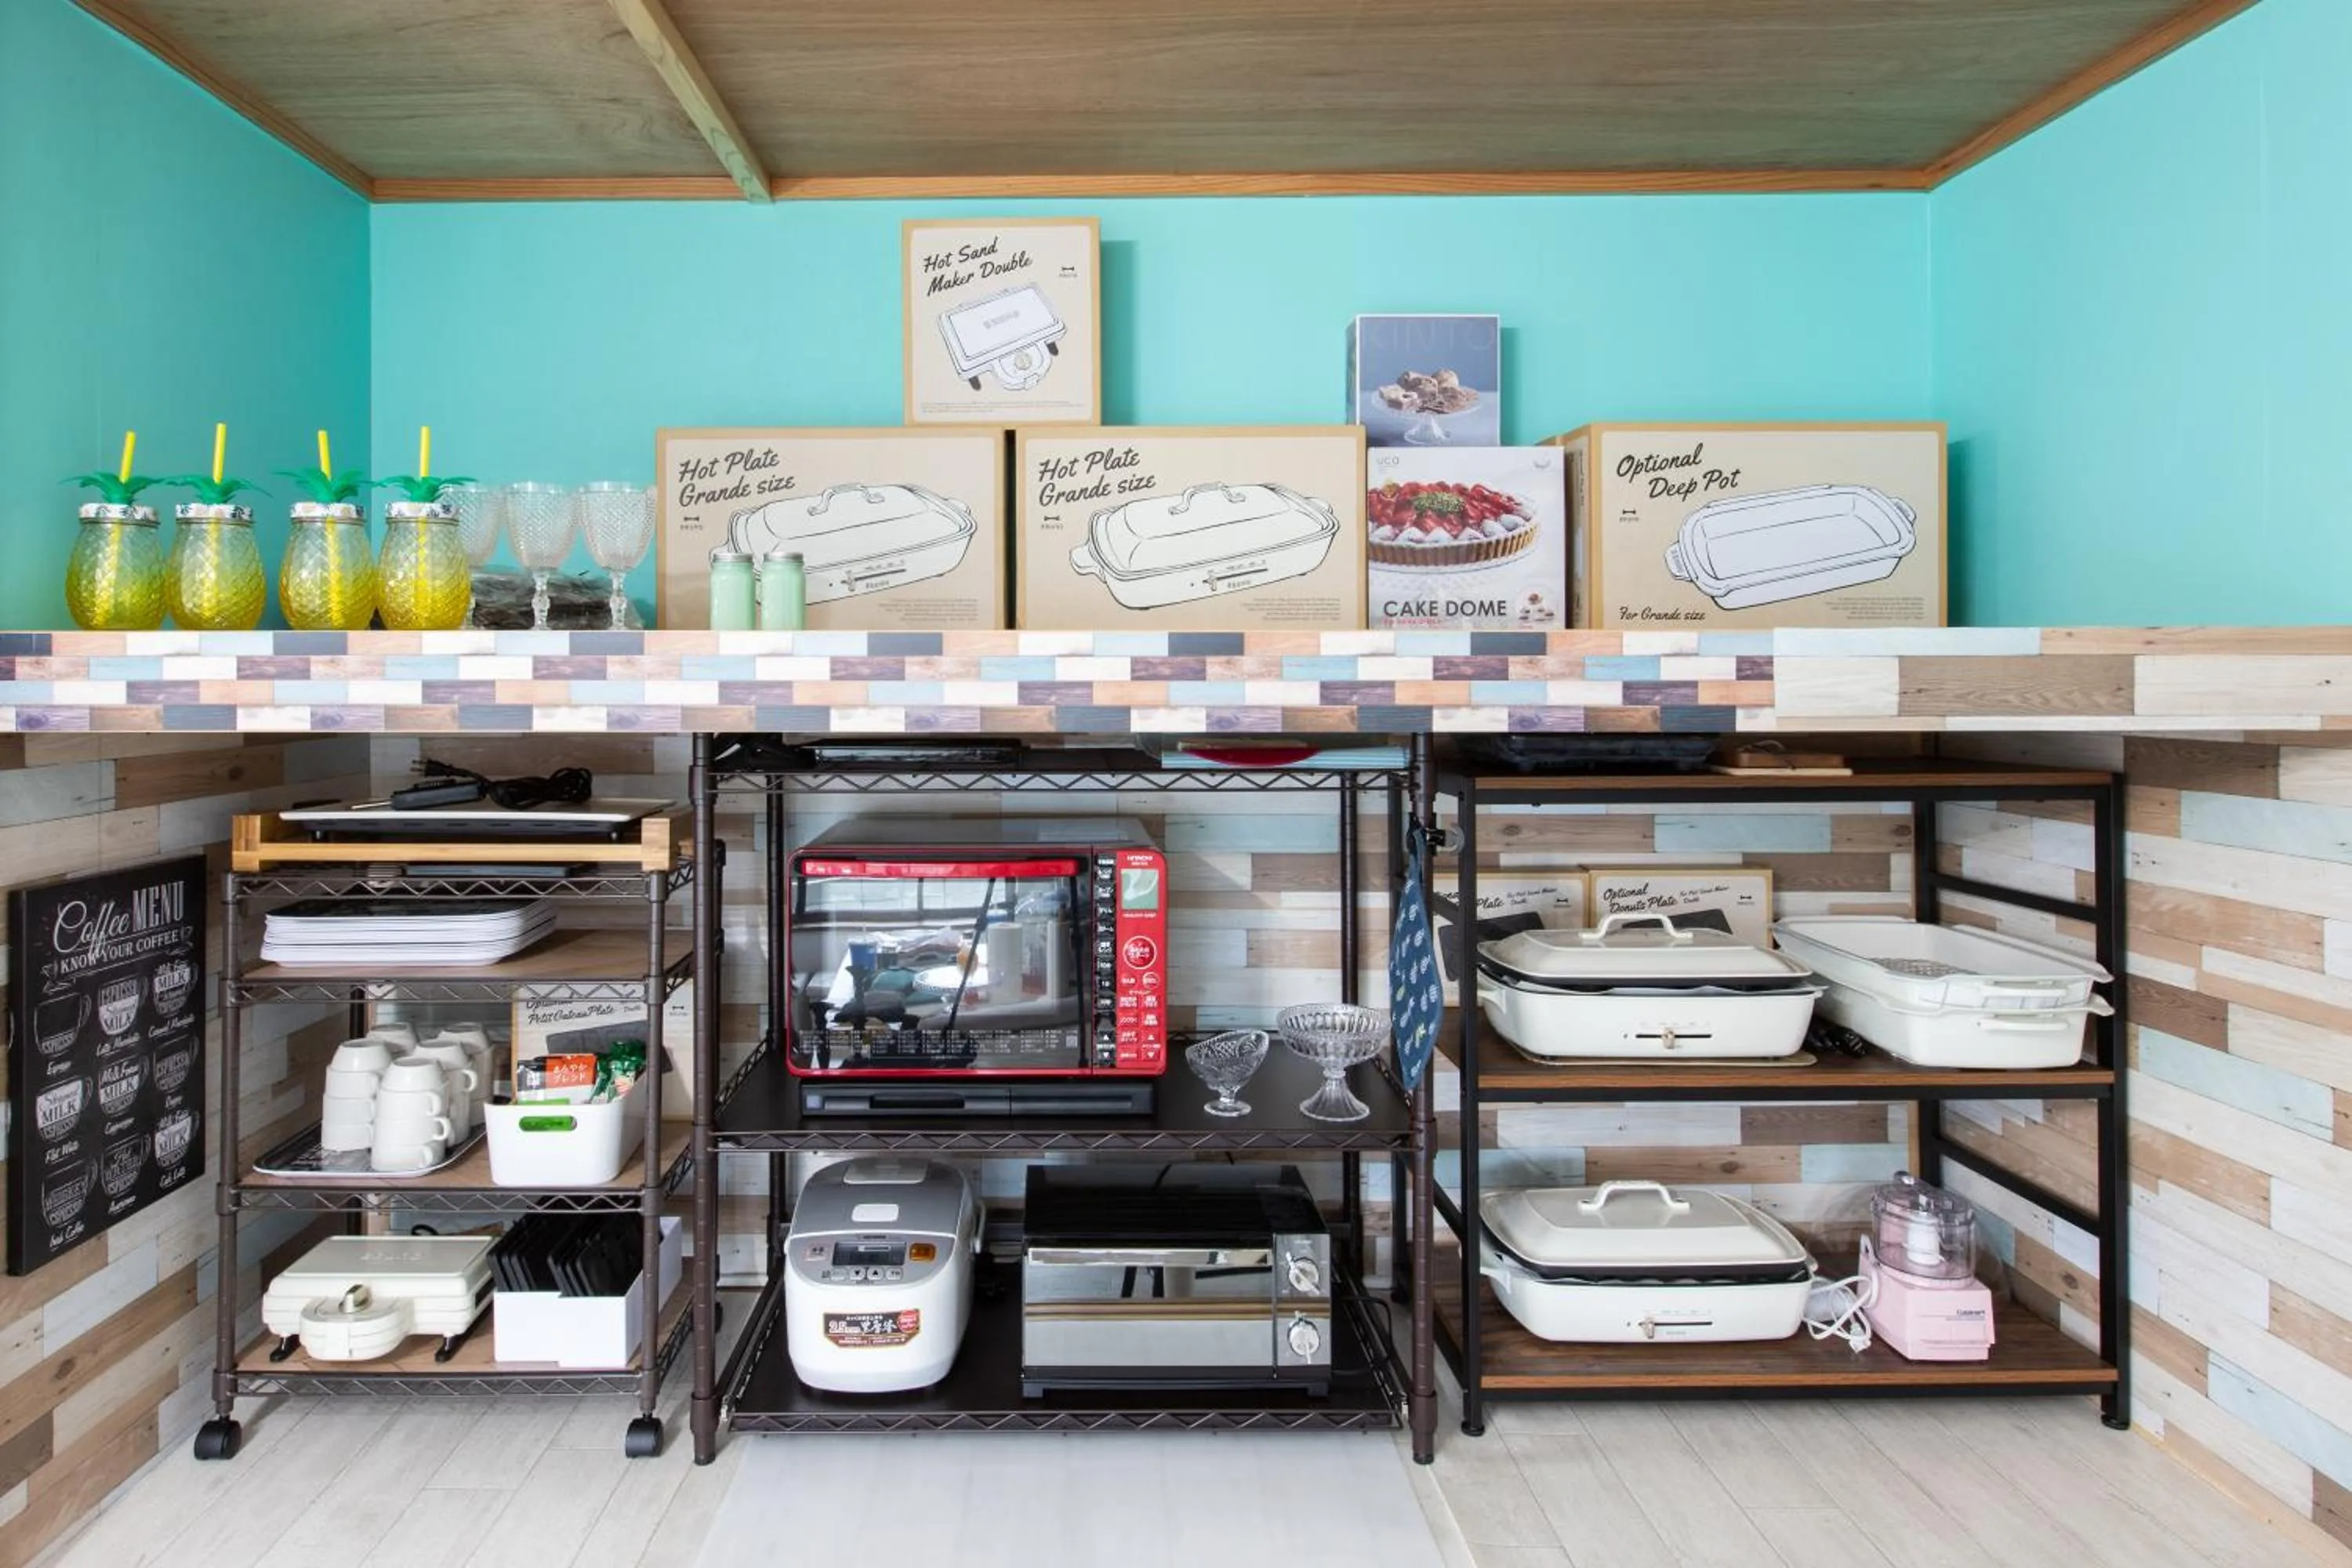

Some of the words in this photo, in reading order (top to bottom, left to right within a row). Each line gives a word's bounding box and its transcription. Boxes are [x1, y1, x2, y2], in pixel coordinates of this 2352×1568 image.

[924, 252, 953, 273] Hot
[958, 236, 998, 263] Sand
[927, 270, 975, 297] Maker
[980, 250, 1033, 278] Double
[679, 458, 720, 483] Hot
[724, 448, 780, 475] Plate
[1039, 458, 1080, 482] Hot
[1084, 448, 1141, 474] Plate
[1617, 442, 1703, 483] Optional
[679, 474, 751, 507] Grande
[757, 474, 796, 495] size
[1039, 474, 1111, 506] Grande
[1117, 474, 1156, 494] size
[1649, 477, 1697, 502] Deep
[1703, 469, 1741, 491] Pot
[1384, 601, 1439, 617] CAKE
[1446, 601, 1506, 616] DOME
[1619, 606, 1638, 619] For
[1642, 606, 1681, 619] Grande
[1684, 610, 1706, 619] size
[1603, 883, 1649, 903] Optional
[1610, 900, 1646, 913] Donuts
[1647, 895, 1678, 908] Plate
[54, 900, 130, 958] Coffee
[132, 880, 184, 931] MENU
[100, 942, 133, 961] YOUR
[136, 929, 179, 953] COFFEE
[104, 1075, 139, 1101] MILK
[42, 1099, 78, 1124] MILK
